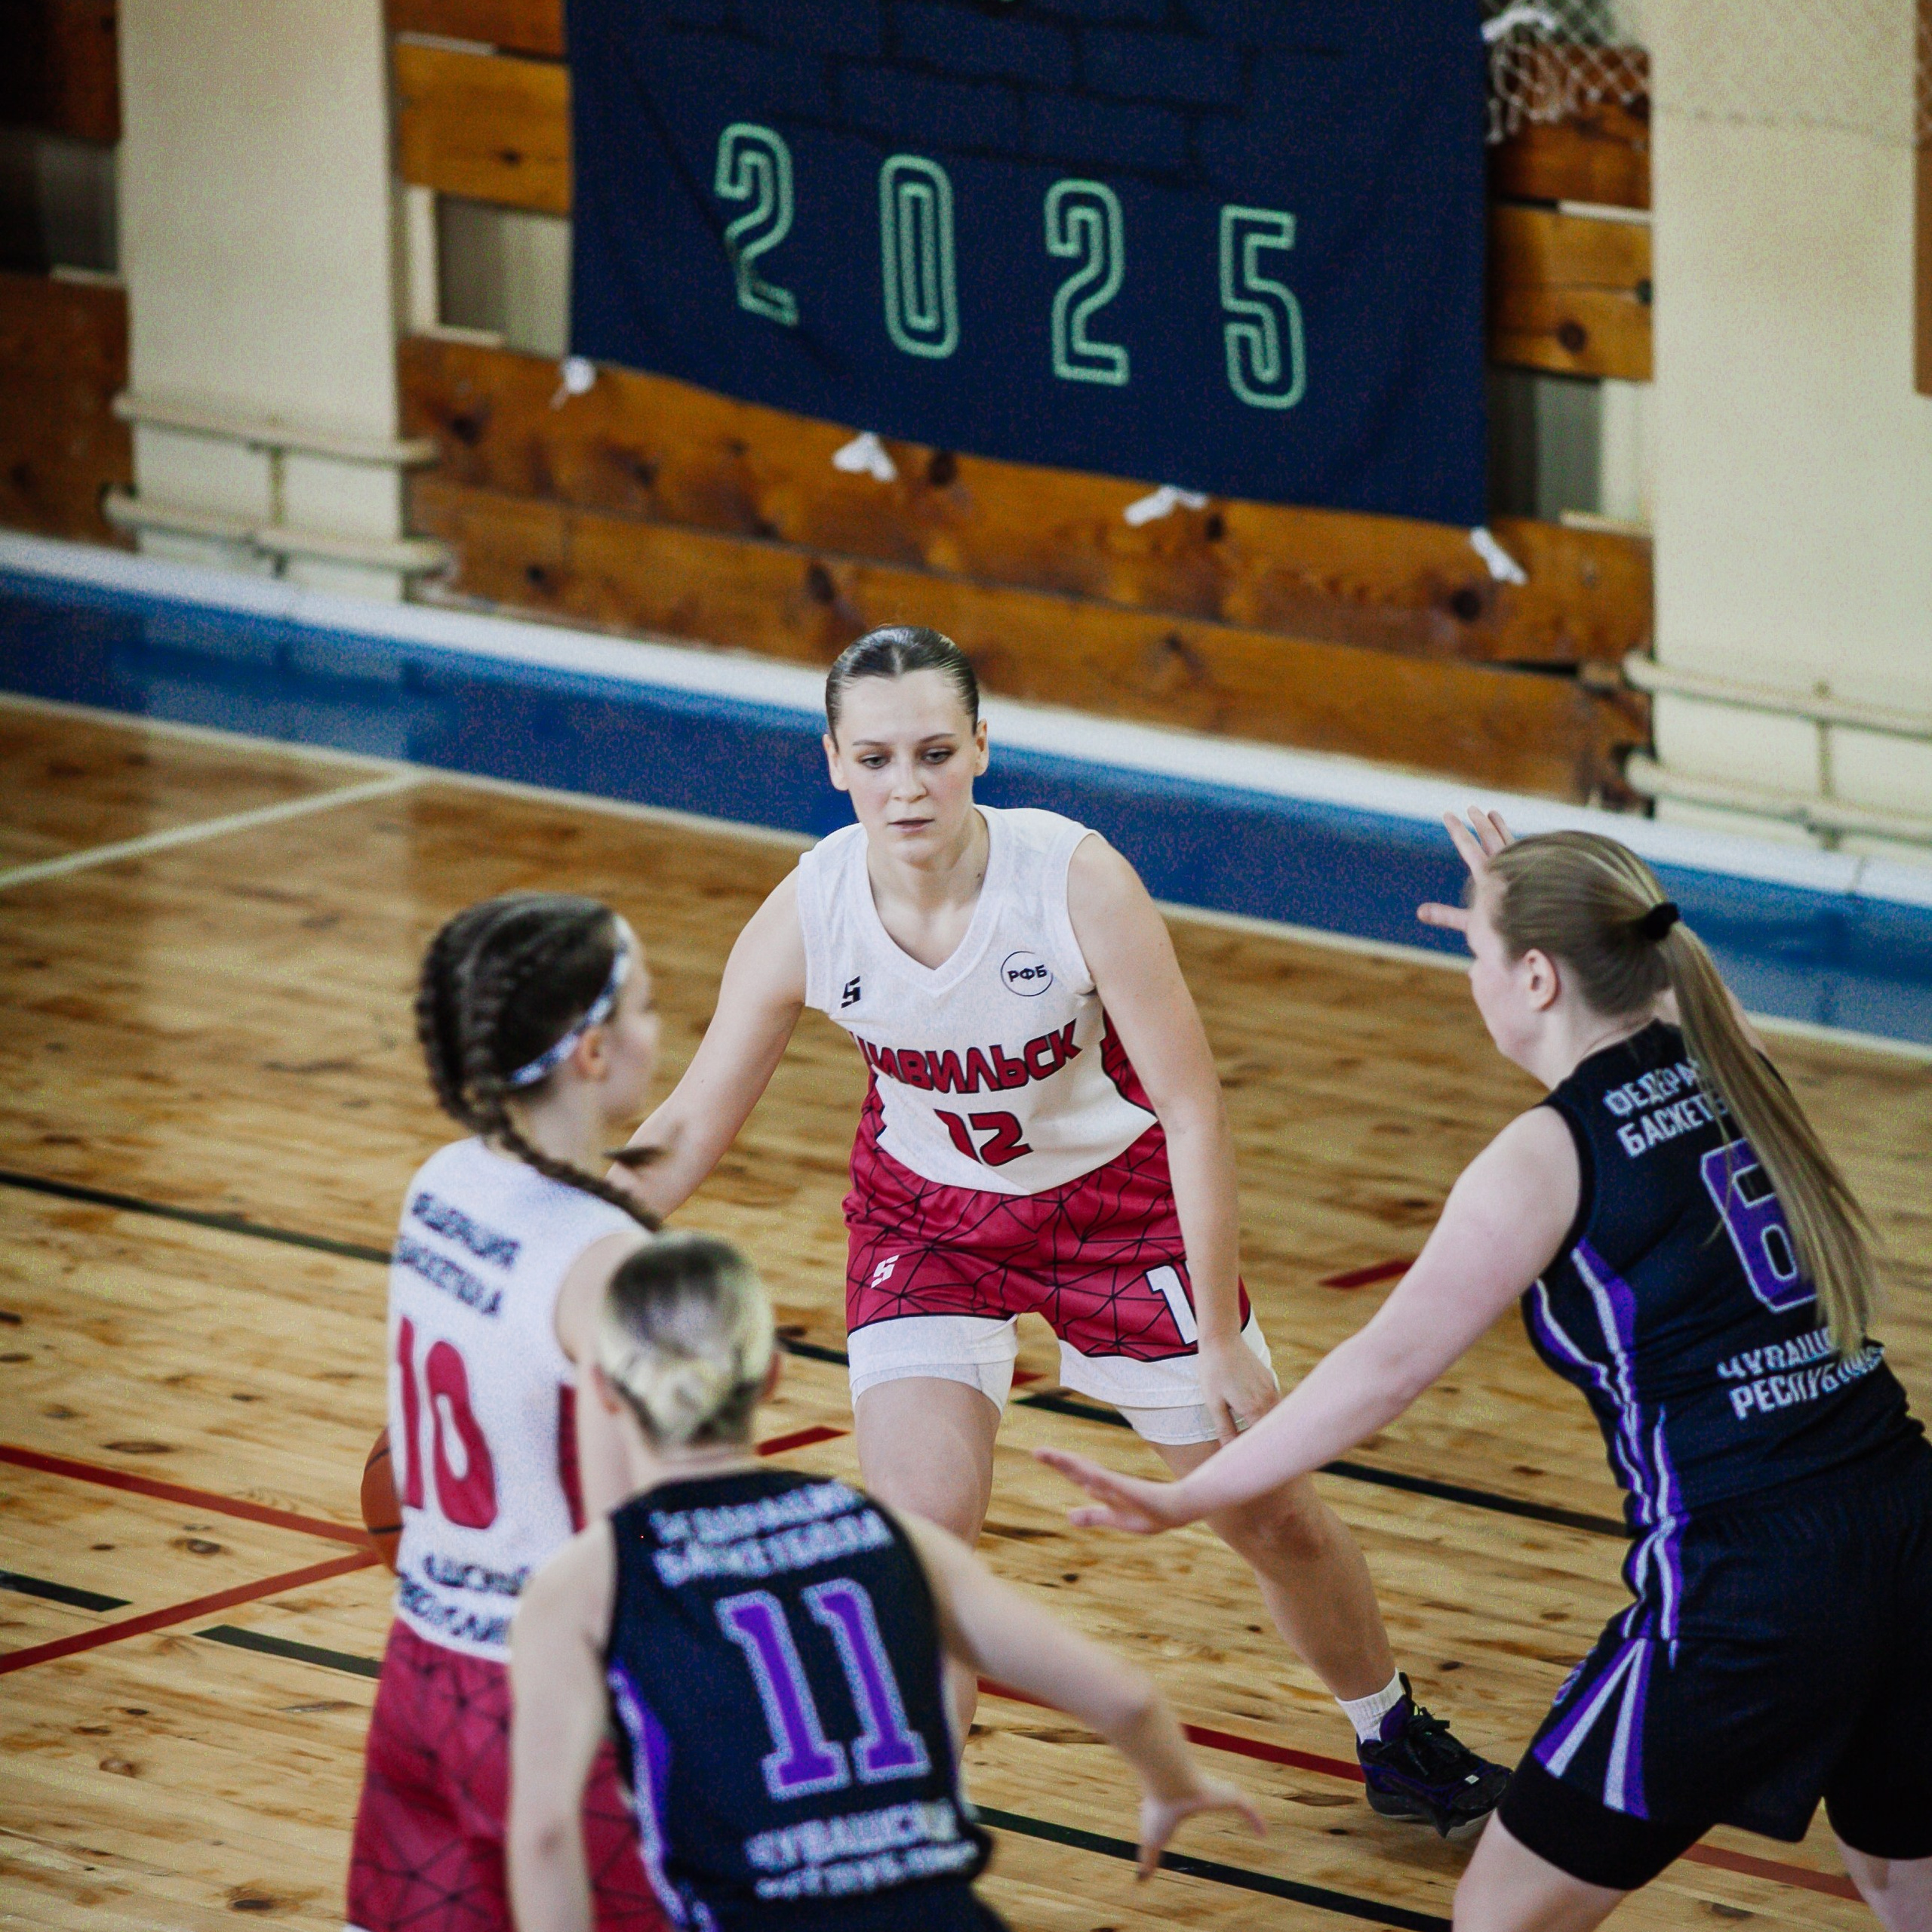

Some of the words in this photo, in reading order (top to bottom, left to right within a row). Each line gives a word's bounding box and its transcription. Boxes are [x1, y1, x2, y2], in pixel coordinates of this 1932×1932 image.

[714, 123, 1307, 409] 2025
[1007, 964, 1048, 983] РФБ
[1602, 1057, 1700, 1118] ФЕДЕРА
[933, 1109, 1035, 1167] 12
[1143, 1261, 1198, 1346] 1
[397, 1315, 499, 1531] 10
[714, 1578, 933, 1801] 11
